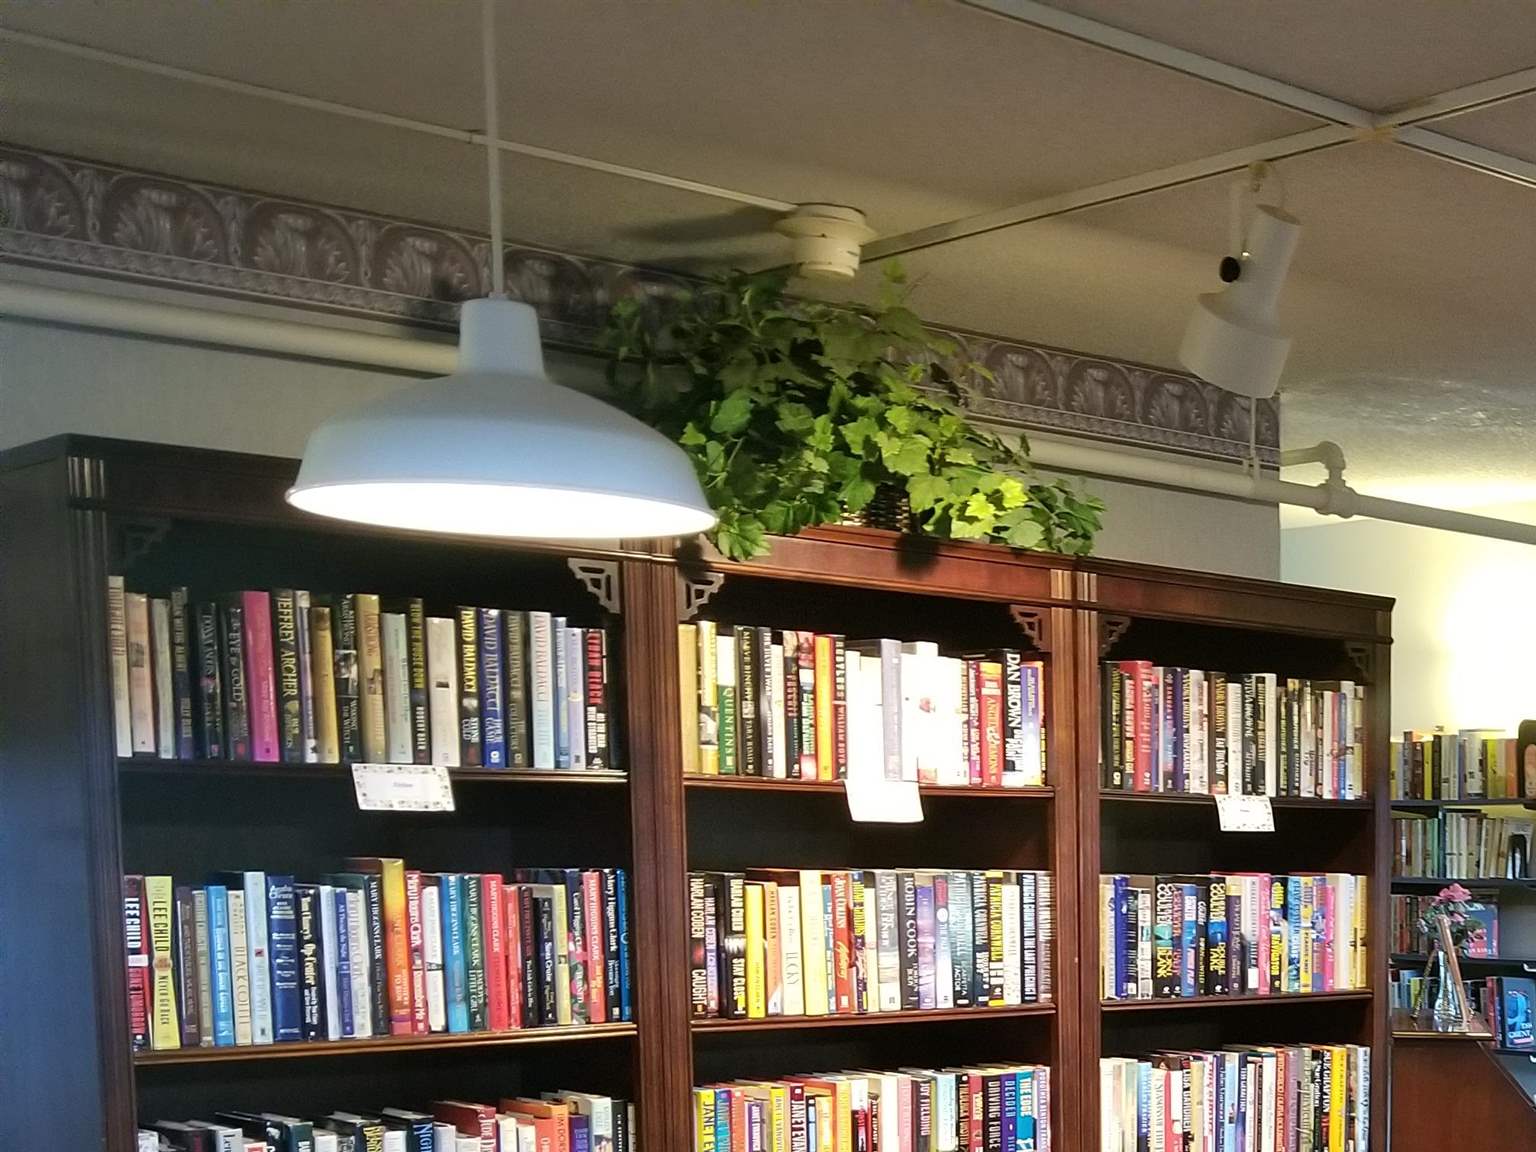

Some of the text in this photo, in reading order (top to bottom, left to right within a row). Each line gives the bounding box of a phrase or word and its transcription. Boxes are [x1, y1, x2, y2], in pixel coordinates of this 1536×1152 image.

[278, 596, 294, 644] JEFFREY
[282, 649, 297, 696] ARCHER
[461, 610, 477, 693] DAVID BALDACCI
[484, 615, 499, 711] DAVID BALDACCI
[508, 615, 521, 688] DAVID BALDACCI
[743, 631, 754, 701] MAEVE BINCHY
[1007, 653, 1021, 728] DAN BROWN
[723, 687, 734, 754] QUENTINS
[1216, 737, 1227, 775] FAT TUESDAY
[369, 881, 378, 902] MARY
[468, 879, 478, 903] MARY
[588, 879, 596, 903] MARY
[605, 874, 616, 896] Mary
[730, 879, 744, 907] HARLAN
[834, 878, 846, 928] JOAN COLLINS
[973, 875, 987, 906] PATRICIA
[1023, 875, 1035, 937] PATRICIA CORNWELL
[1157, 884, 1167, 924] COULTER
[125, 898, 141, 948] LEE CHILD
[153, 901, 169, 952] LEE CHILD
[604, 897, 616, 927] Higgins
[690, 879, 704, 938] HARLAN COBEN
[903, 877, 916, 957] ROBIN COOK
[990, 884, 1003, 960] PATRICIA CORNWELL
[301, 943, 317, 985] Op-Center
[732, 958, 744, 976] STAY
[1210, 948, 1219, 971] TAKE
[1272, 934, 1283, 976] NAVIGATOR
[129, 968, 145, 1034] GONE TOMORROW
[413, 971, 423, 1020] Remember Me
[692, 969, 706, 1005] CAUGHT
[791, 1100, 803, 1128] JANET
[920, 1083, 930, 1136] JOY FIELDING
[988, 1081, 1000, 1149] DRIVING FORCE
[1005, 1081, 1015, 1117] DECIDER
[1020, 1078, 1032, 1117] THE EDGE
[1183, 1091, 1191, 1132] GARDNER
[703, 1102, 714, 1136] JANET
[224, 1134, 235, 1152] Len
